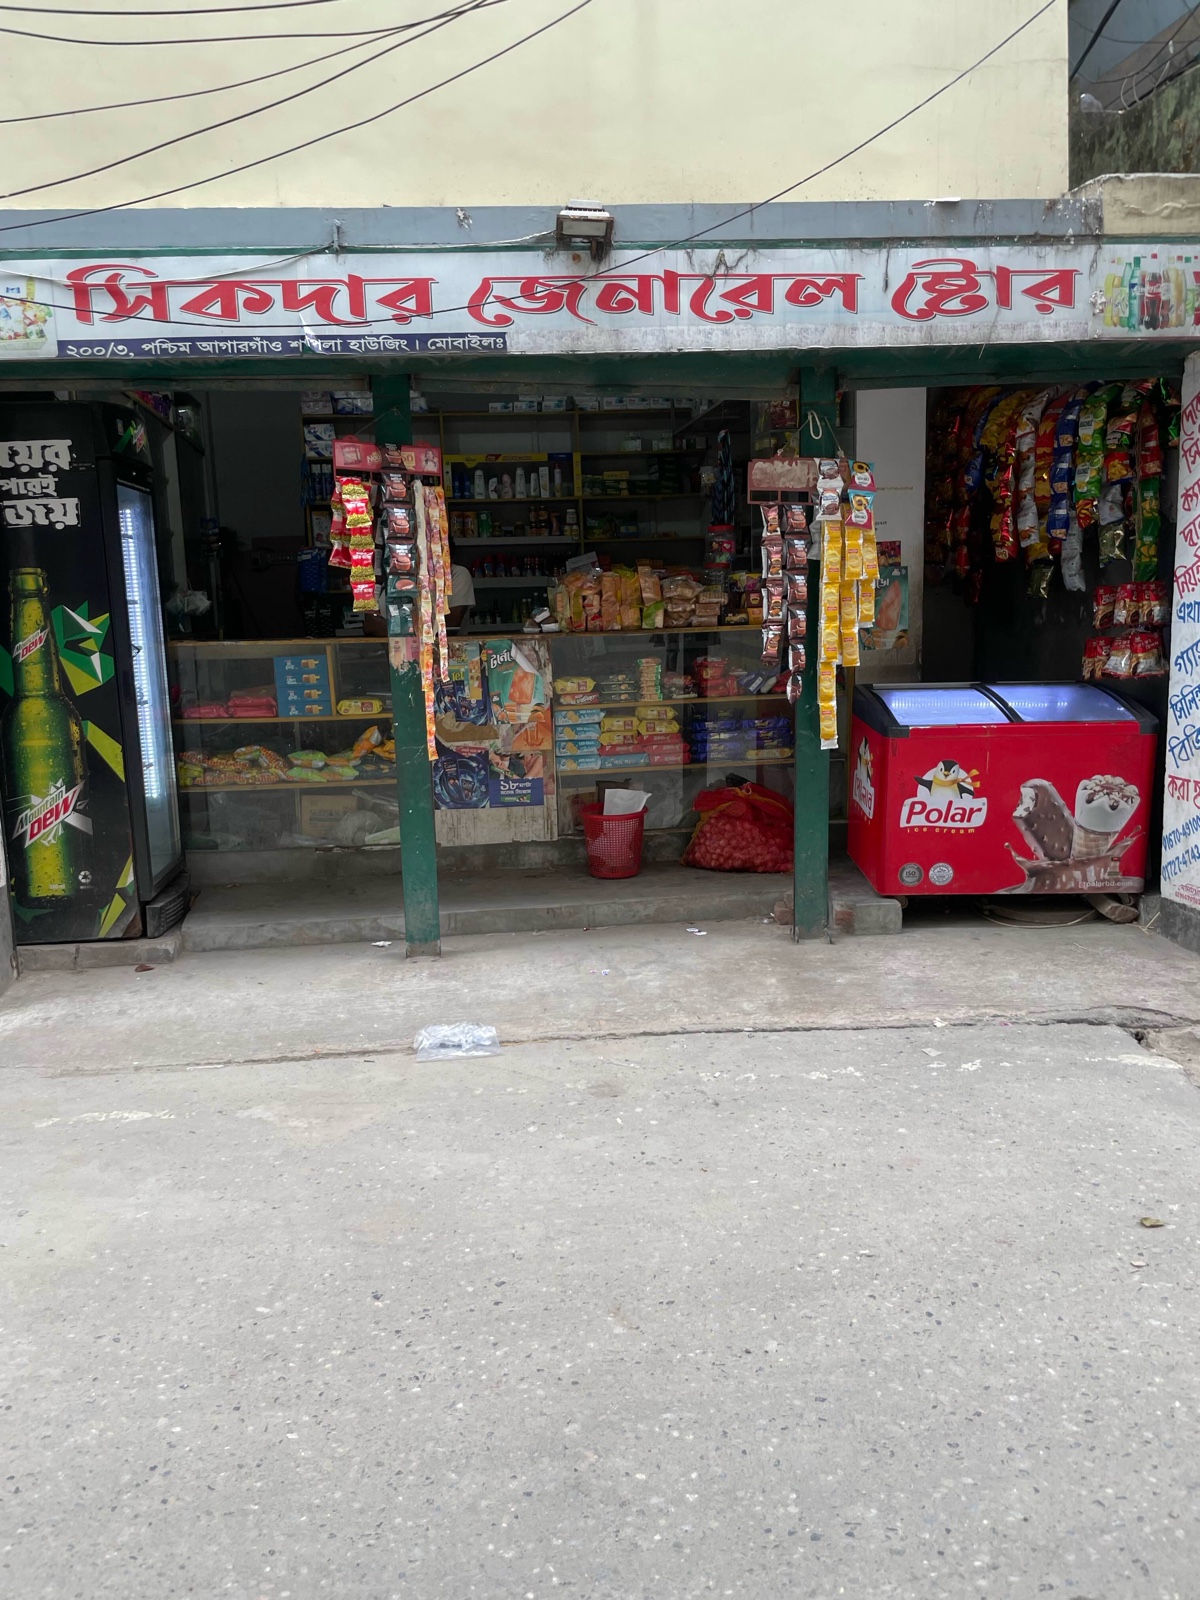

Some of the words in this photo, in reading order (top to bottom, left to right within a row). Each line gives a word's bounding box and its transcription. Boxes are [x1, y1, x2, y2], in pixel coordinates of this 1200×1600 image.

[64, 263, 438, 327] সিকদার
[468, 269, 865, 327] জেনারেল
[141, 337, 192, 354] পশ্চিম
[197, 336, 282, 355] আগারগাঁও
[347, 335, 410, 353] হাউজিং
[0, 440, 72, 473] য়ের
[16, 789, 64, 834] Mountain
[905, 799, 983, 825] Polar
